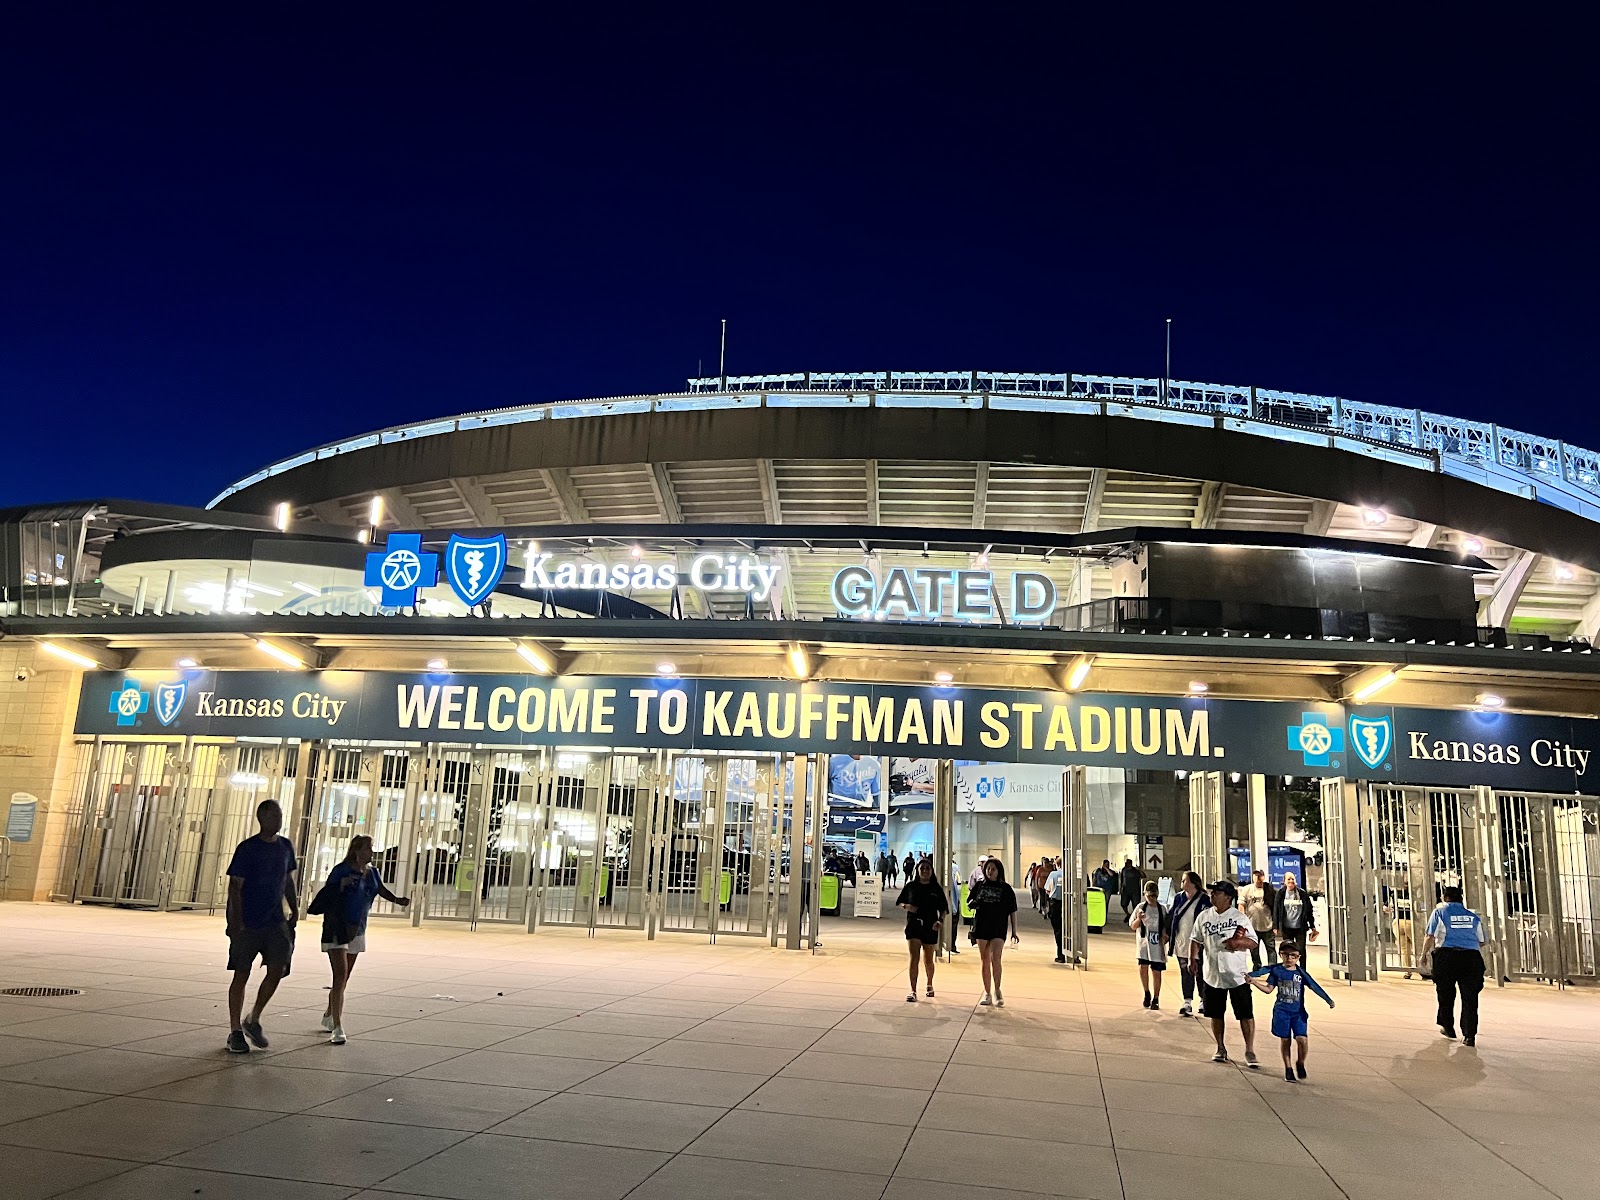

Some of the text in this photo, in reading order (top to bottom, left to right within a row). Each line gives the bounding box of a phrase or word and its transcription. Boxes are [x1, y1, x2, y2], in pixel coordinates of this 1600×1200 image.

[520, 553, 781, 601] Kansas City
[831, 565, 1057, 621] GATE D
[195, 691, 347, 725] Kansas City
[397, 684, 1225, 758] WELCOME TO KAUFFMAN STADIUM.
[1408, 731, 1591, 776] Kansas City
[1009, 780, 1062, 793] Kansas Cit
[1204, 918, 1237, 937] Royals
[1450, 915, 1474, 923] BEST
[1293, 974, 1302, 983] KC
